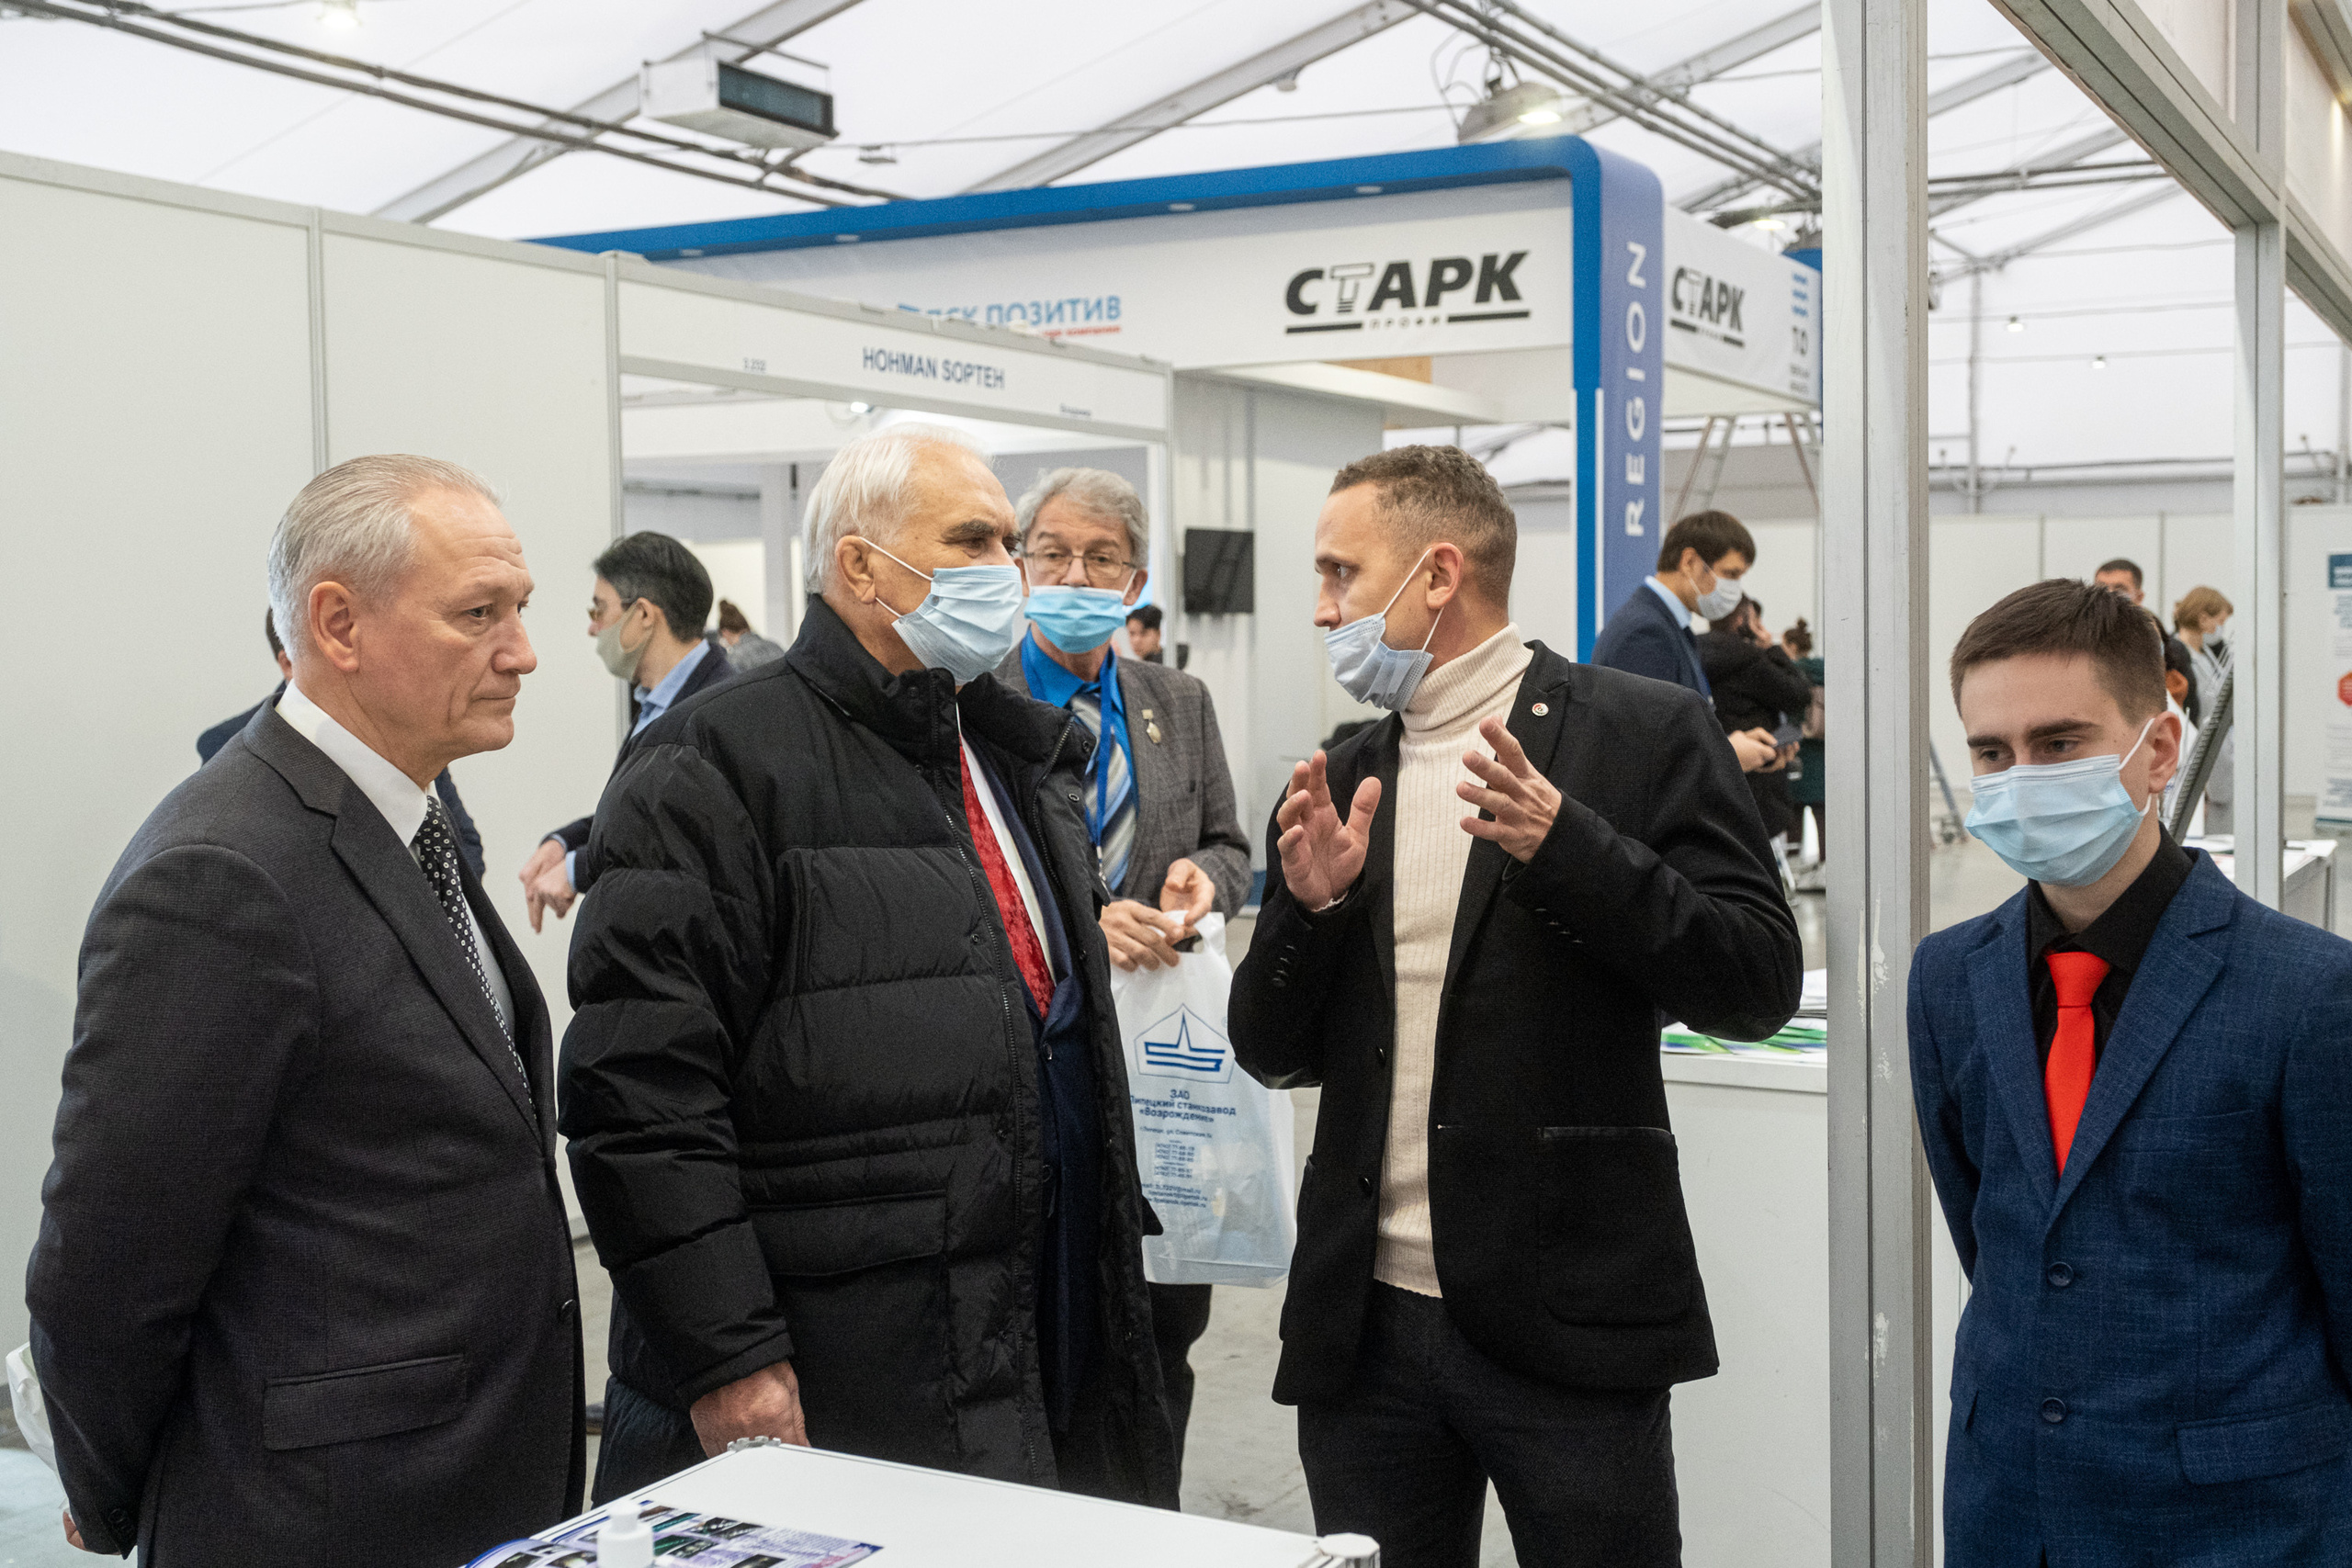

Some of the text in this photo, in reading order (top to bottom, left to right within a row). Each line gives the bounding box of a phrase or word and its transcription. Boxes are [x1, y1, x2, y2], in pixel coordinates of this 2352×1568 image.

[1285, 250, 1530, 315] СТАРК
[1671, 265, 1746, 332] СТАРК
[986, 295, 1122, 326] ПОЗИТИВ
[862, 346, 1006, 389] HOHMAN SOPTEH
[1624, 241, 1647, 536] REGION
[1170, 1089, 1191, 1100] ЗАО
